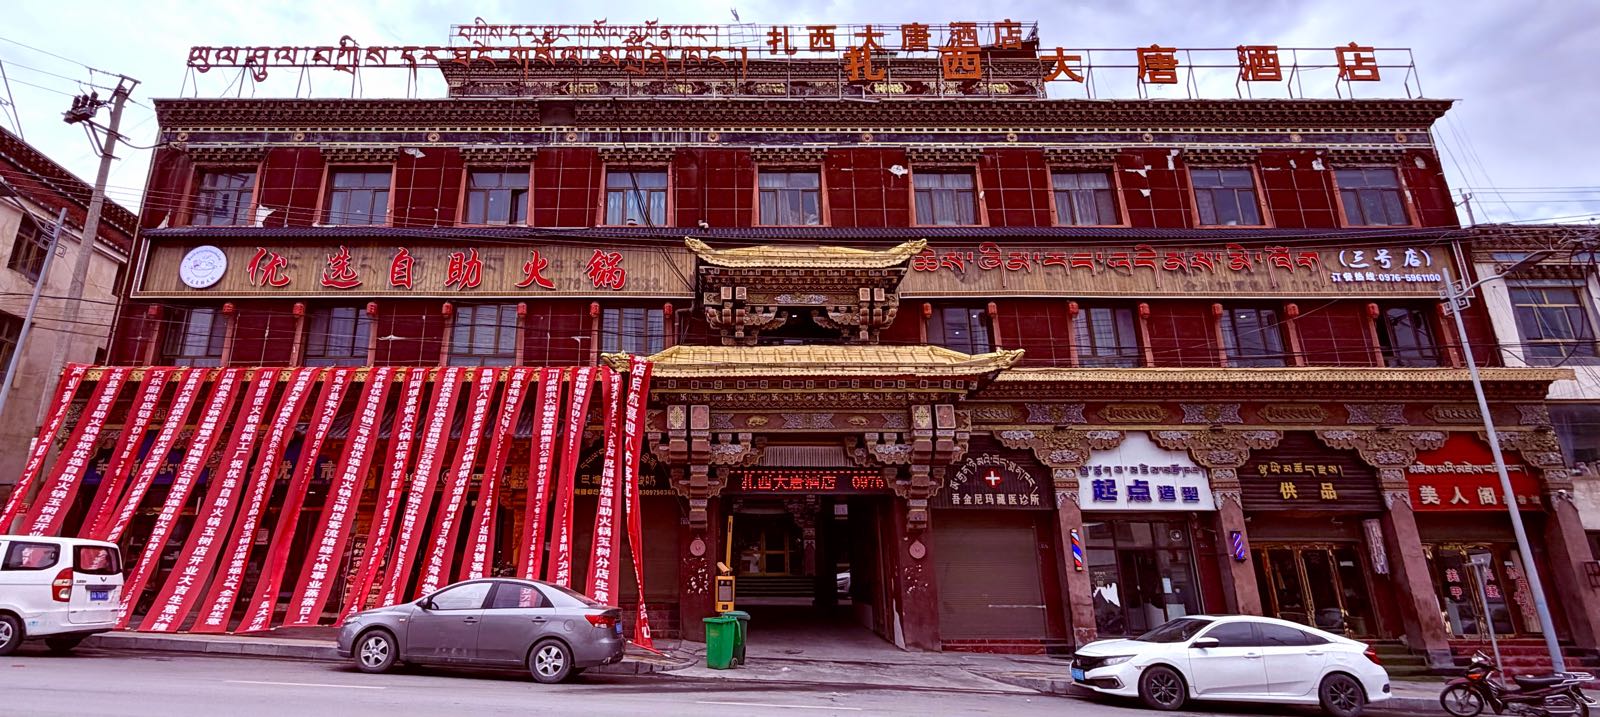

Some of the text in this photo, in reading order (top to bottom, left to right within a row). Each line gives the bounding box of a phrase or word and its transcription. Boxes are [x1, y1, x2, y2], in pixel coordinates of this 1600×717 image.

[766, 19, 1022, 55] 扎西大唐酒店
[844, 42, 1380, 83] 扎西大唐酒店
[247, 245, 627, 290] 优选自助火锅
[852, 476, 884, 489] 0976
[1092, 479, 1200, 503] 起点造型
[1280, 482, 1338, 500] 供品
[951, 493, 1040, 506] 吾金尼玛藏医诊所
[1419, 485, 1497, 505] 美人阁
